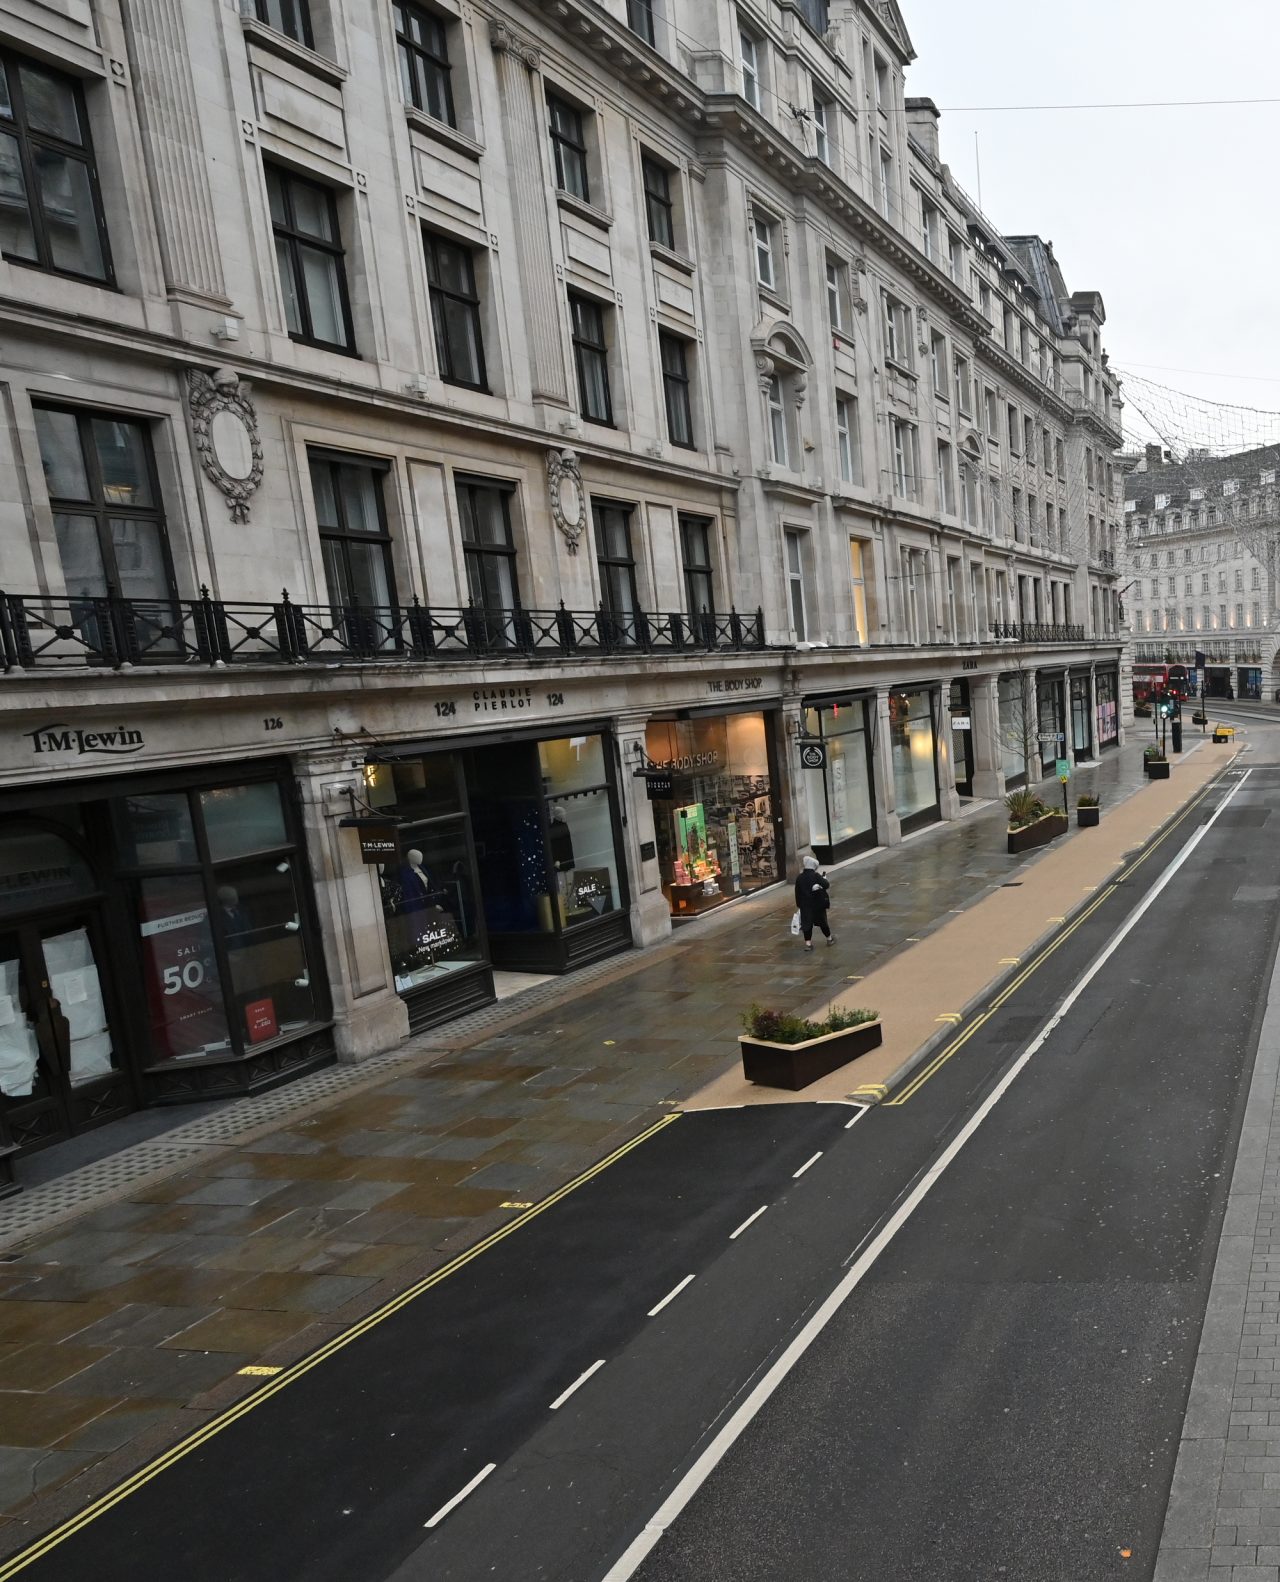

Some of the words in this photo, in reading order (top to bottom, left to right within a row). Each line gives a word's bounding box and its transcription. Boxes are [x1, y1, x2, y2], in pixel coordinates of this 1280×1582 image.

[962, 660, 977, 670] ZARA
[707, 680, 723, 692] THE
[724, 679, 744, 691] BODY
[744, 677, 762, 689] SHOP
[473, 688, 531, 700] CLAUDIE
[546, 693, 564, 706] 124
[434, 702, 456, 716] 124
[474, 699, 531, 711] PIERLOT
[263, 717, 284, 731] 126
[696, 751, 718, 766] SHOP
[578, 884, 597, 896] SALE
[157, 919, 183, 929] FURTHER
[422, 928, 447, 944] SALE
[163, 960, 204, 995] 50
